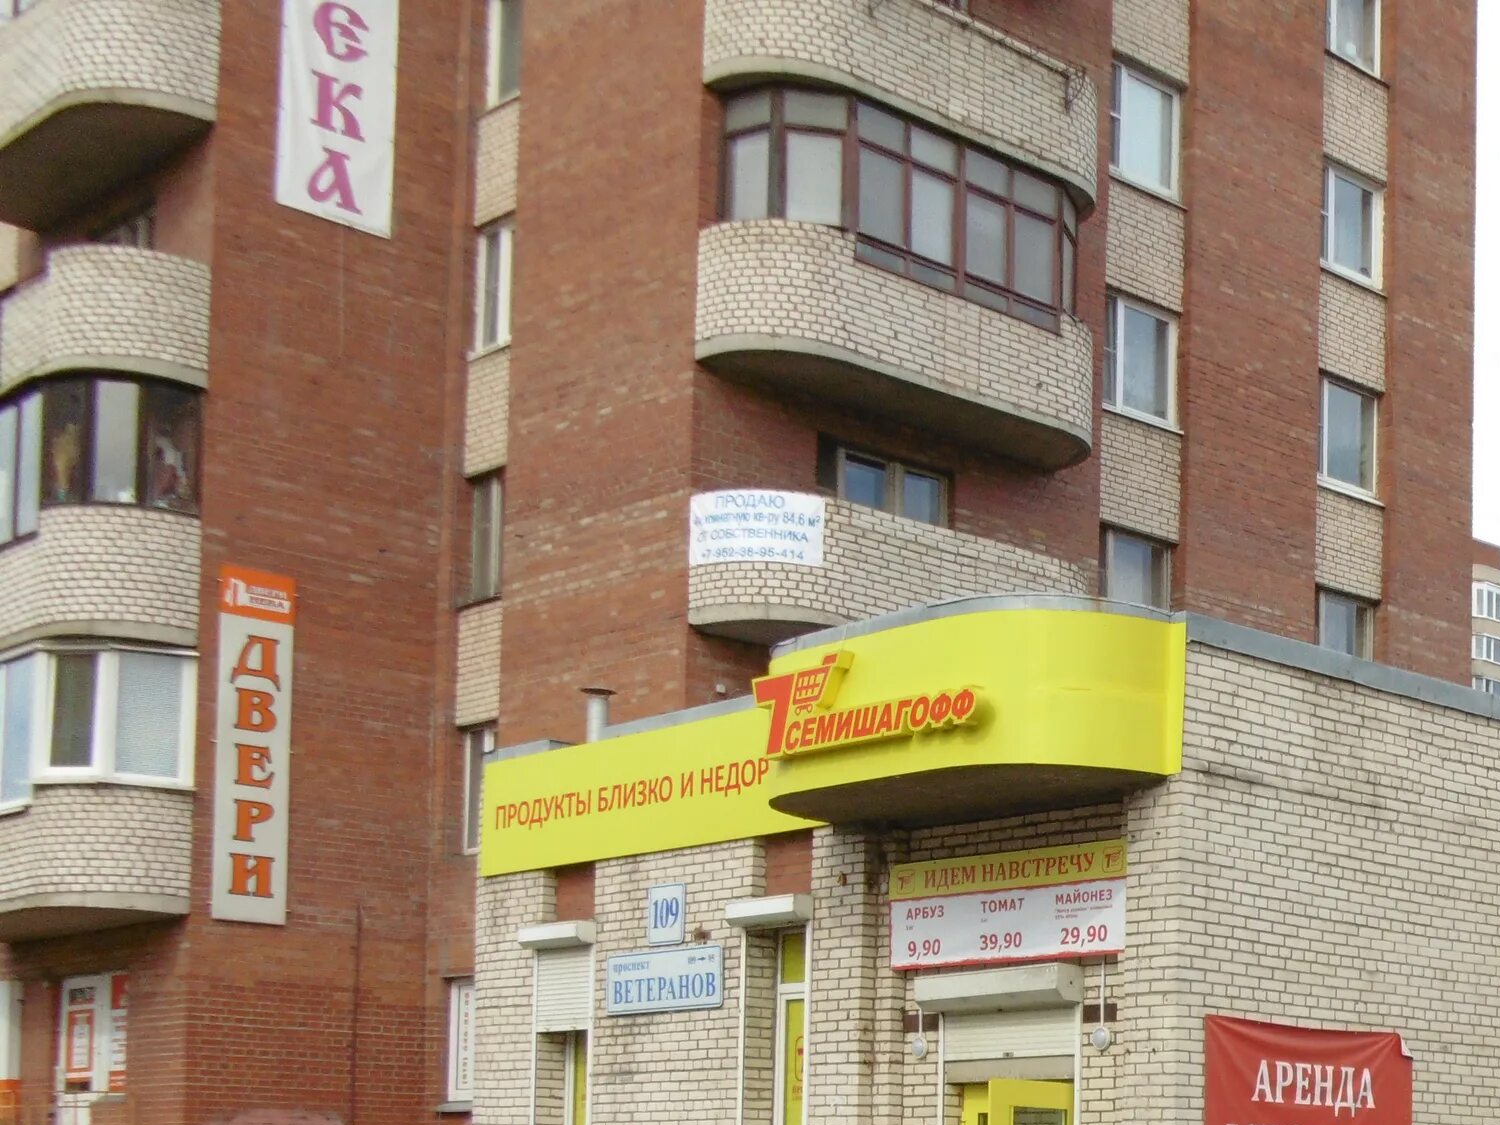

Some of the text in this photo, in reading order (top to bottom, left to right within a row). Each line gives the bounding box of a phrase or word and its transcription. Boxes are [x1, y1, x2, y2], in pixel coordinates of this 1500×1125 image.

[715, 494, 786, 509] ПРОДАЮ
[710, 527, 809, 543] СОБСТВЕННИКА
[785, 689, 975, 751] СЕМИШАГОФФ
[228, 633, 282, 899] ДВЕРИ
[495, 789, 592, 830] ПРОДУКТЫ
[597, 775, 673, 813] БЛИЗКО
[680, 771, 694, 799] И
[924, 864, 976, 892] ИДЕМ
[981, 851, 1095, 883] НАВСТРЕЧУ
[980, 897, 1026, 914] ТОМАТ
[1055, 888, 1113, 906] МАЙОНЕЗ
[652, 896, 680, 929] 109
[906, 904, 945, 921] АРБУЗ
[979, 931, 1023, 953] 39,90
[1060, 924, 1108, 947] 29,90
[907, 938, 941, 961] 9,90
[613, 960, 650, 975] проспект
[613, 972, 716, 1005] ВЕТЕРАНОВ
[1251, 1059, 1376, 1118] АРЕНДА
